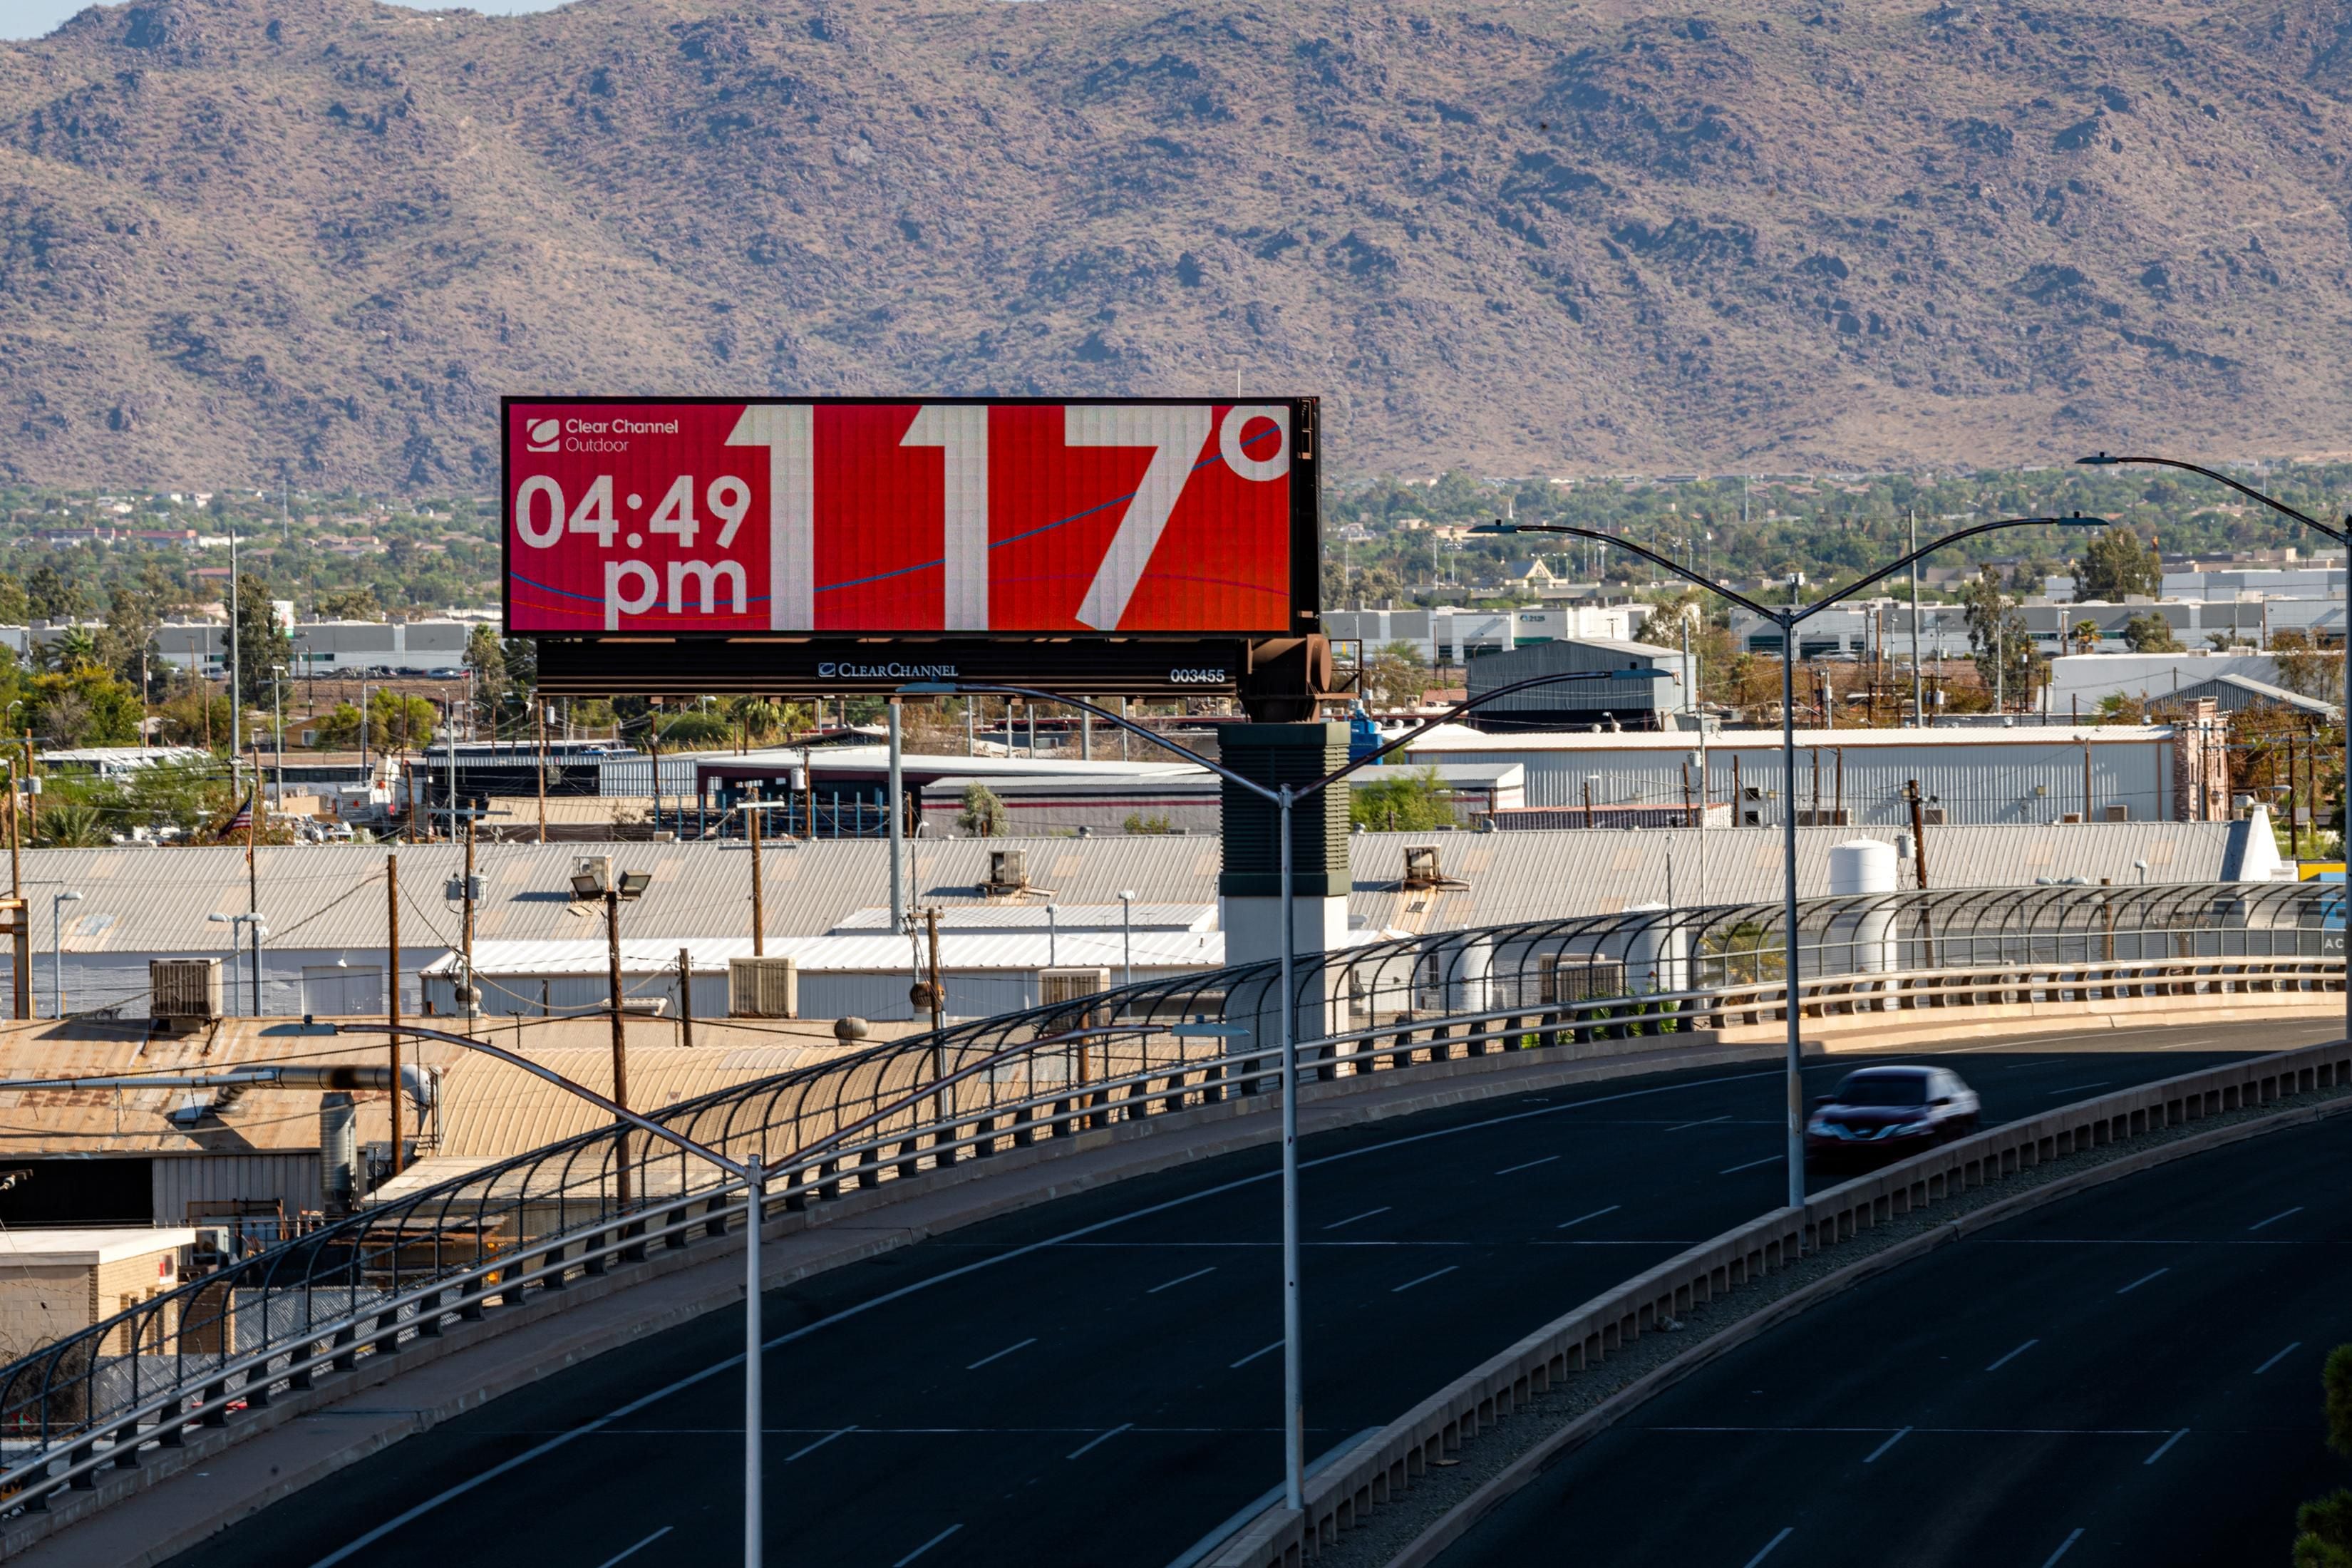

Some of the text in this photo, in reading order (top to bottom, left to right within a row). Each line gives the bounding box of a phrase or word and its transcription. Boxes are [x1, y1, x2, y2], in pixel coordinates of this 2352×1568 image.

[565, 418, 679, 434] Clear Channel
[565, 436, 629, 452] Outdoor
[515, 475, 751, 549] 04:49
[604, 559, 747, 631] pm
[1170, 669, 1225, 683] 003455
